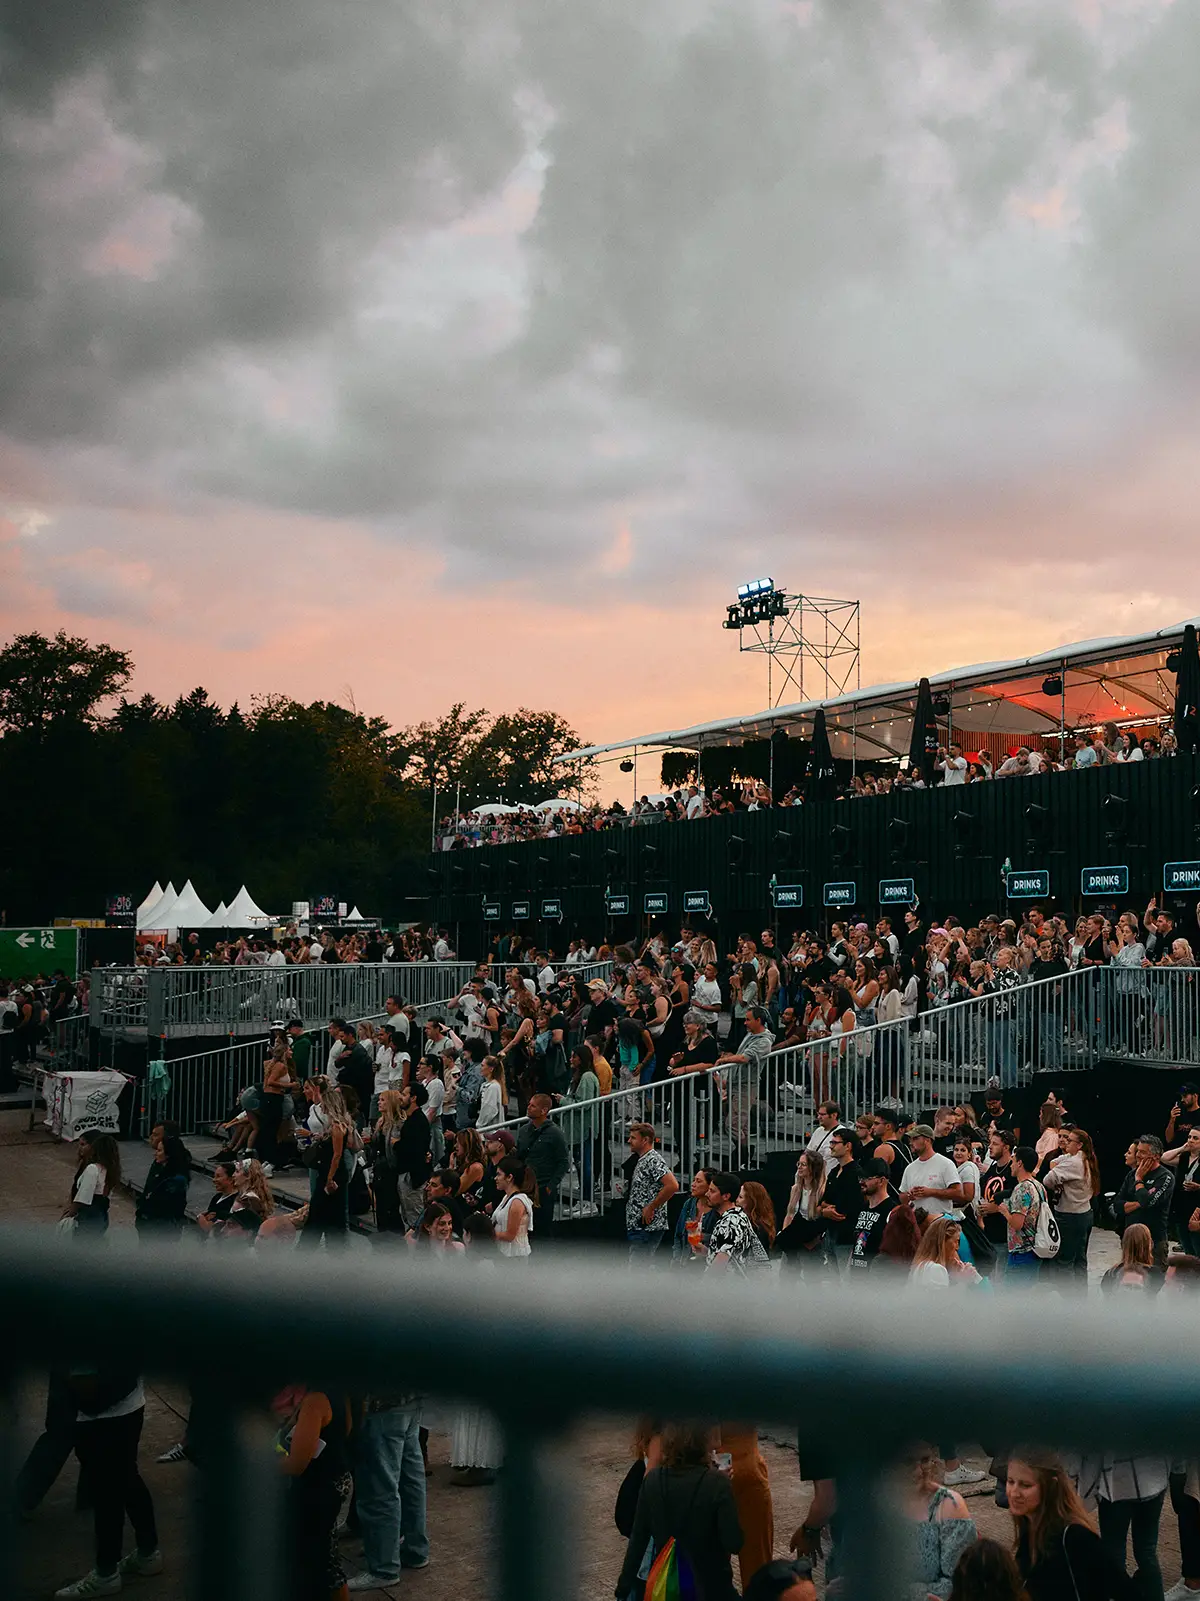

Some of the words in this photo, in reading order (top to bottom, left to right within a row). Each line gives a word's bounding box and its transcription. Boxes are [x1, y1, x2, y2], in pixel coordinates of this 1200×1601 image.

[1013, 879, 1041, 890] DRINKS
[1089, 875, 1120, 886] DRINKS
[828, 889, 850, 899] DRINKS
[884, 886, 908, 896] DRINKS
[778, 892, 797, 901] DRINKS
[610, 901, 625, 909] DRINKS
[647, 899, 663, 908] DRINKS
[687, 897, 704, 906] DRINKS
